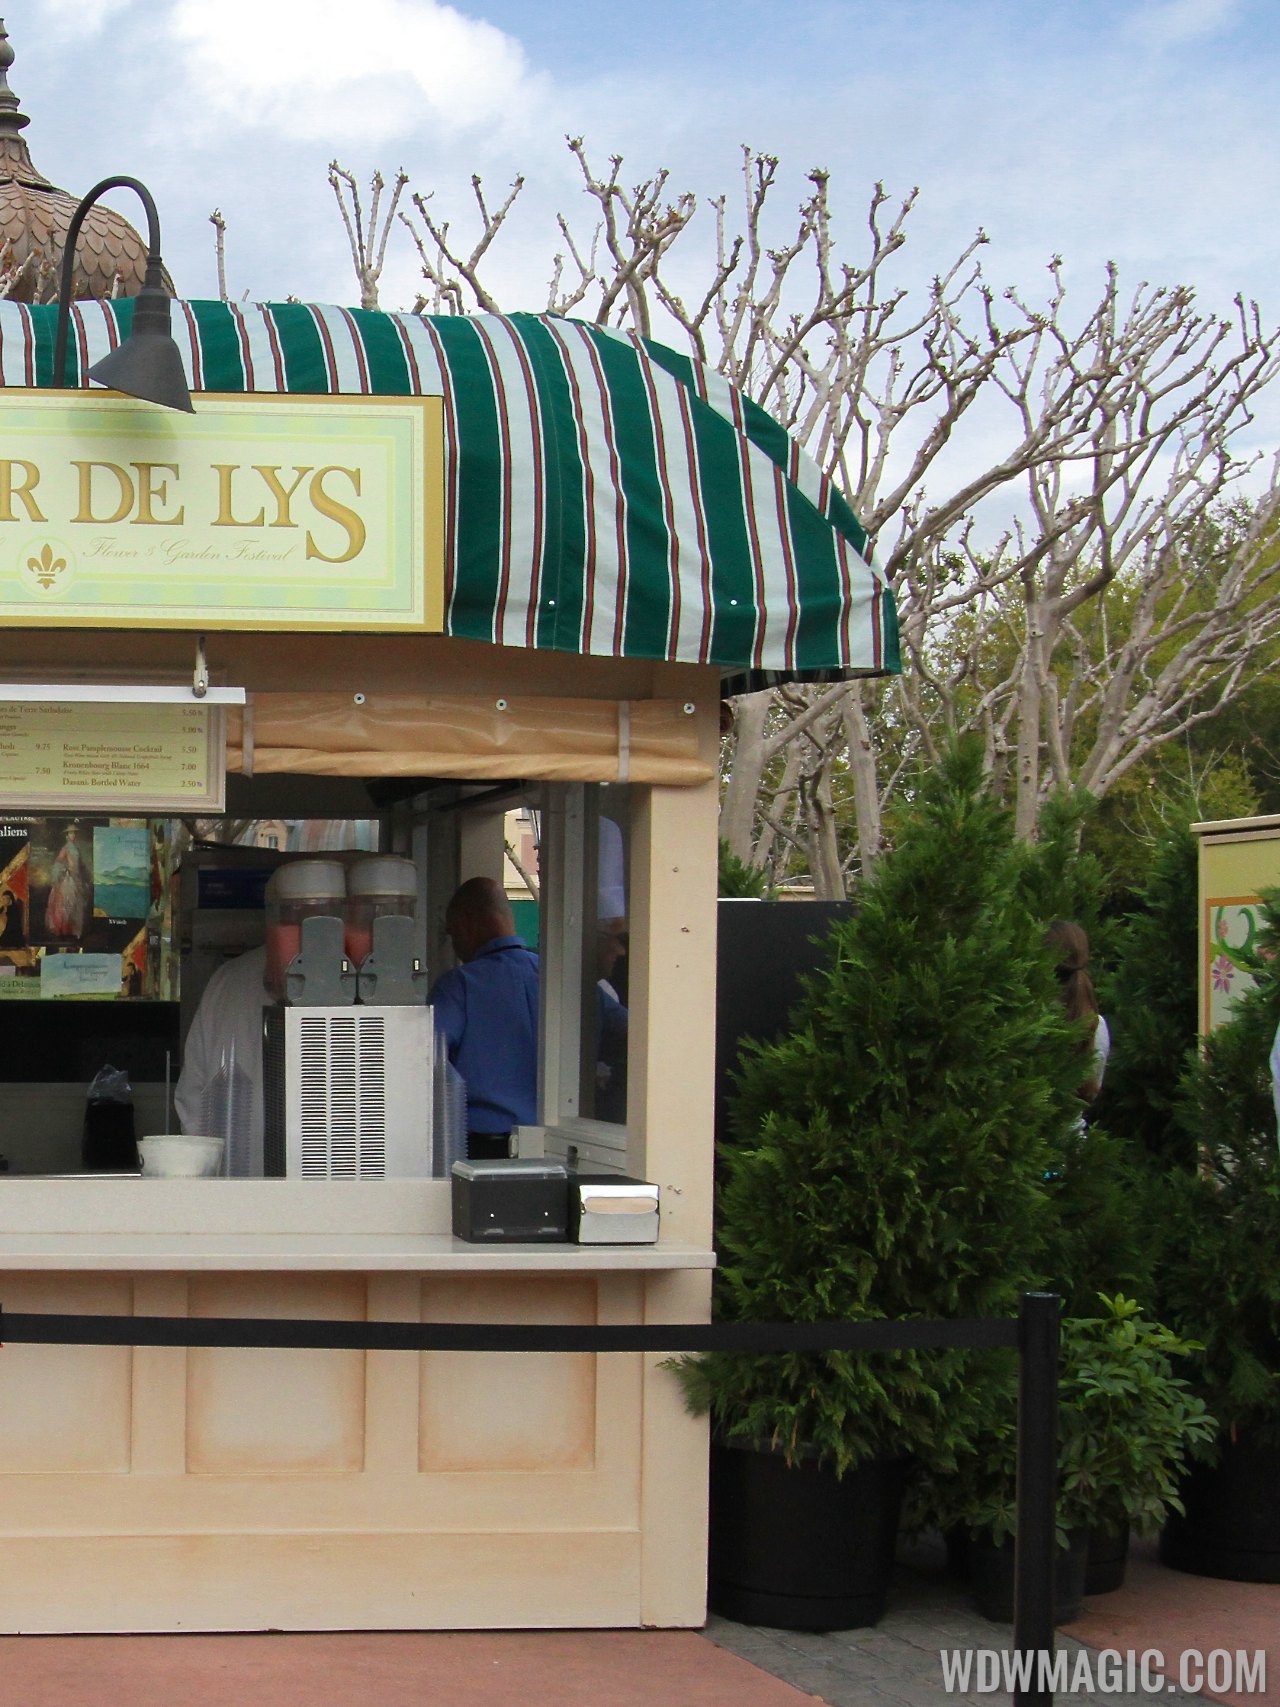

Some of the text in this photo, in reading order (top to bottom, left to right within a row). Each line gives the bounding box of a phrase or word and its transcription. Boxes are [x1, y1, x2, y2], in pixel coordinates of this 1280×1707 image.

[69, 459, 186, 527] DE
[210, 463, 367, 564] LYS
[82, 536, 138, 560] Flower
[159, 538, 220, 566] Garden
[225, 539, 299, 561] Festival
[35, 743, 51, 751] 9.75
[133, 744, 163, 753] Cocktail
[35, 767, 51, 775] 7.50
[62, 761, 197, 771] Kronenbourg Blanc 1664 7.00
[91, 778, 118, 787] Bottled
[118, 779, 142, 788] Water
[180, 780, 197, 788] 2.50
